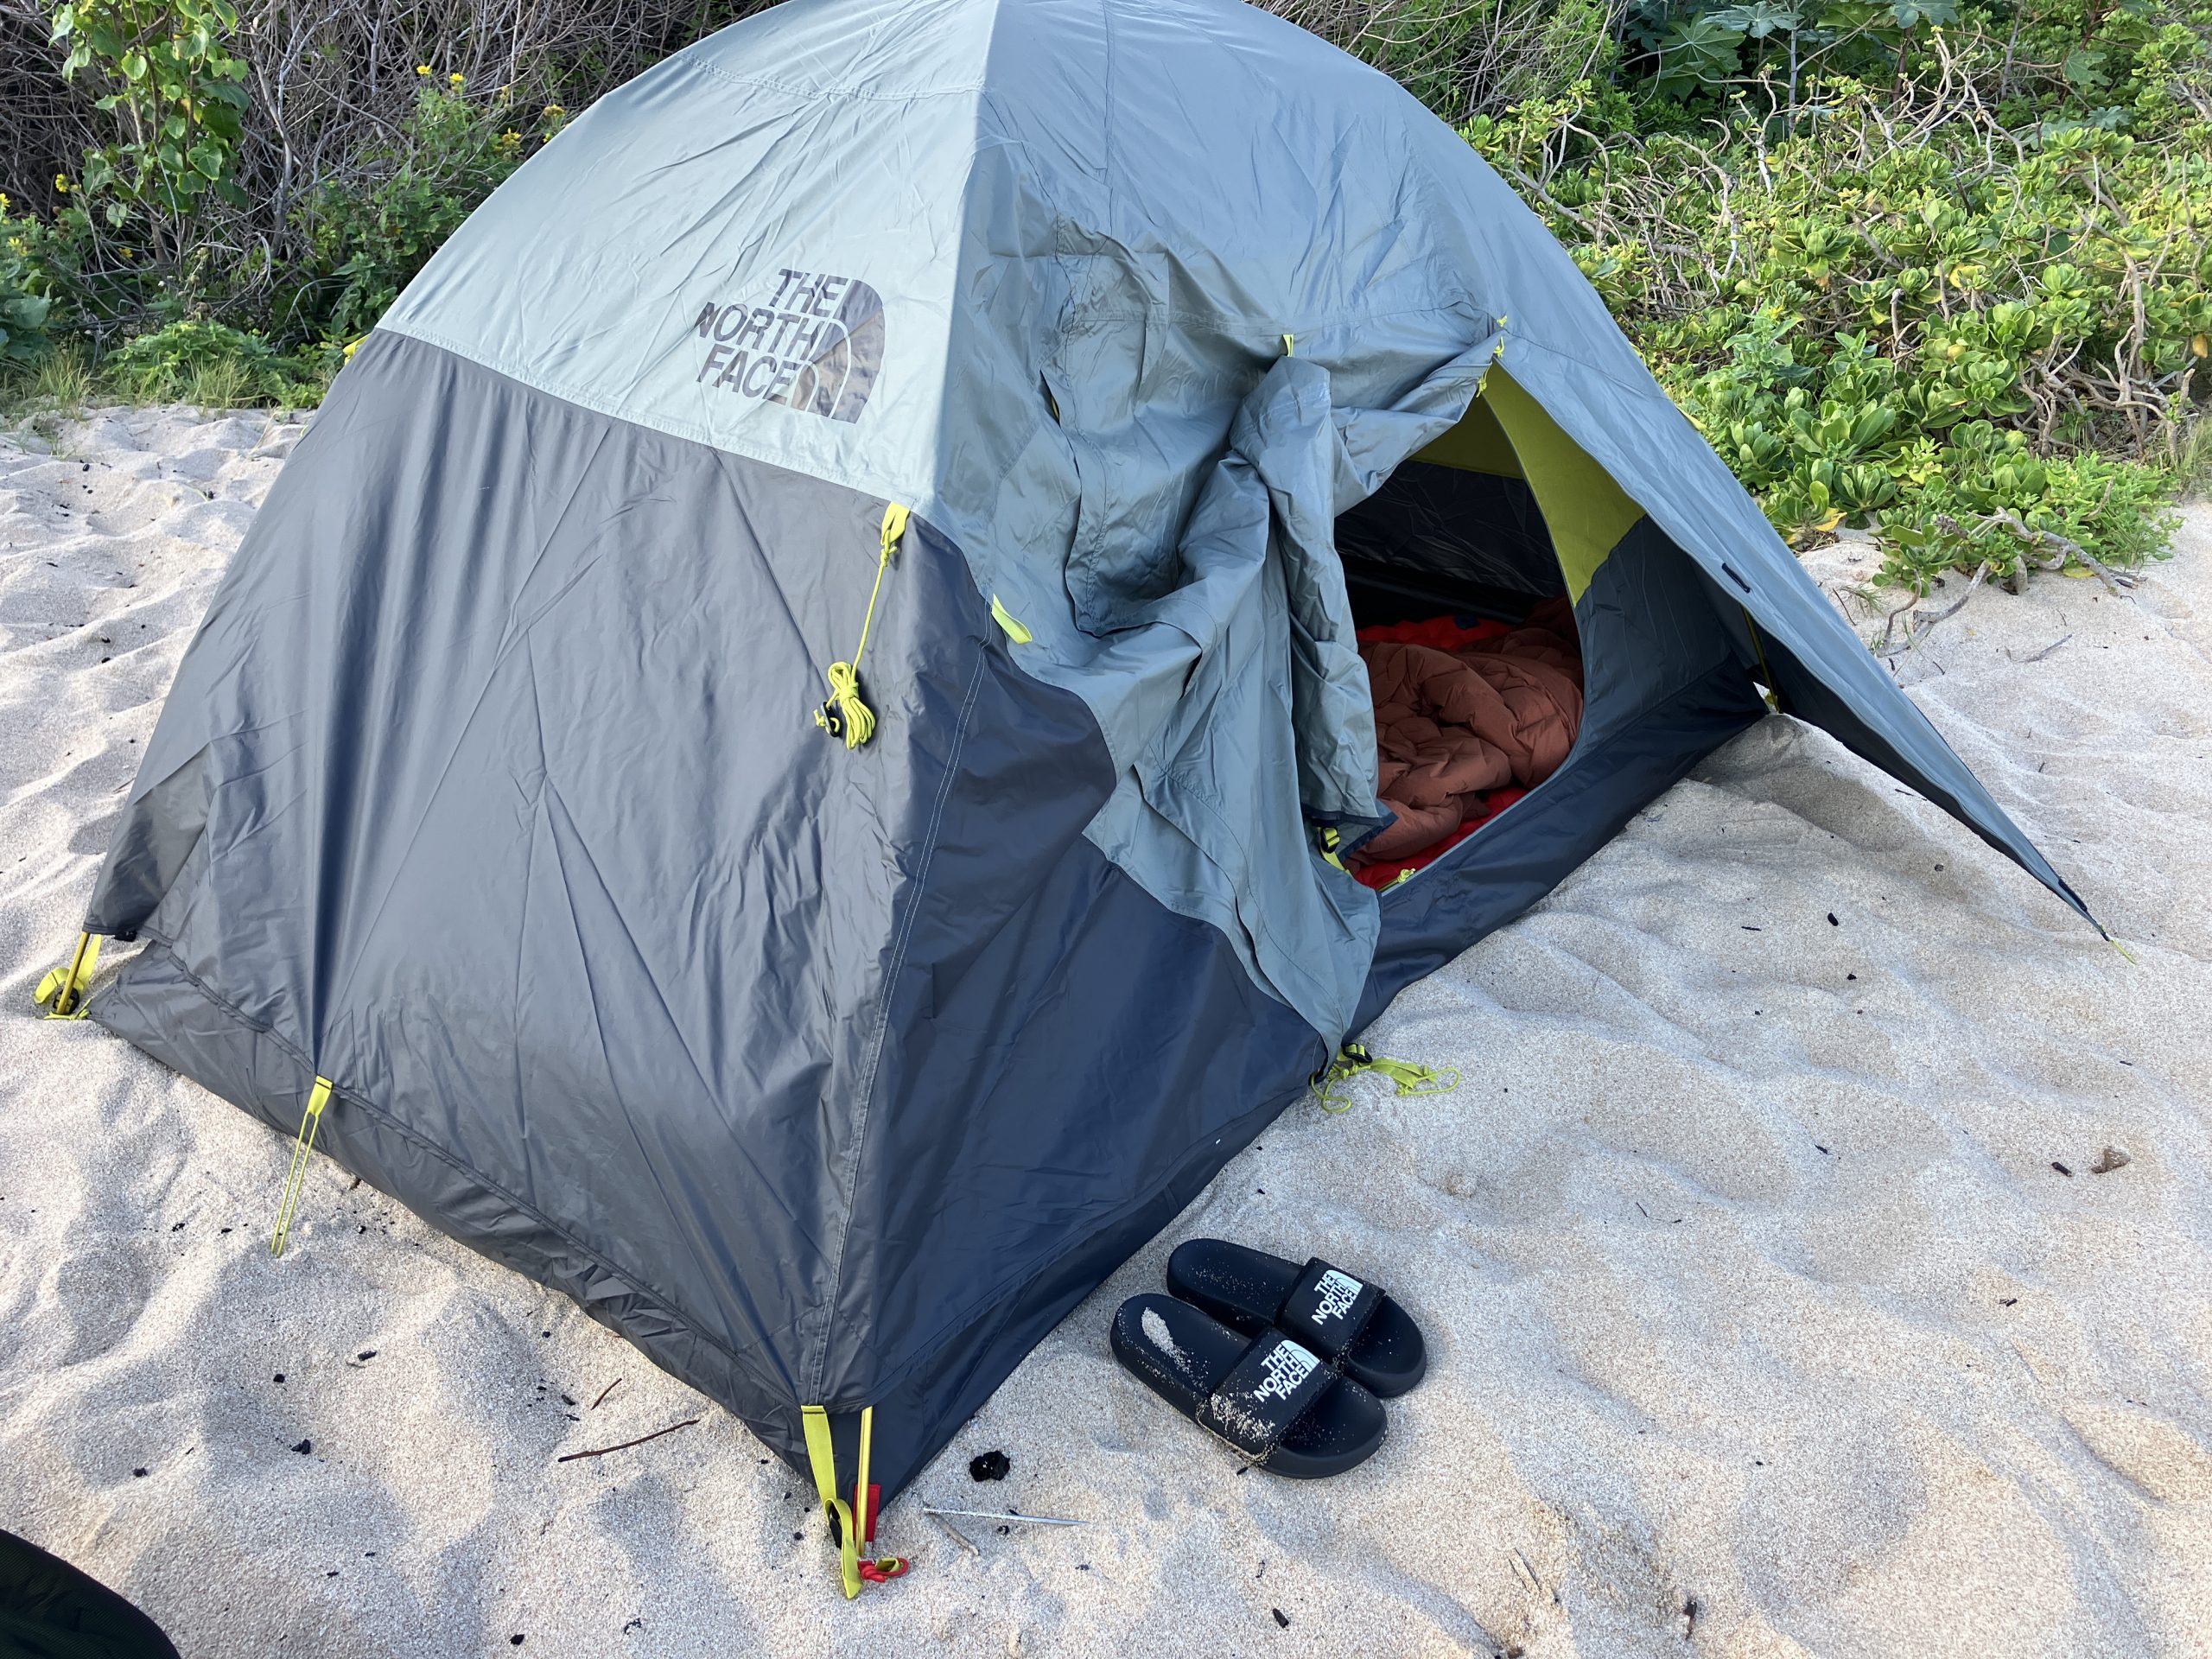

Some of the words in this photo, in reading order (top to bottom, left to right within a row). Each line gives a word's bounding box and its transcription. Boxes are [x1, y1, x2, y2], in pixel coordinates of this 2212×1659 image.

[769, 269, 849, 317] THE
[694, 302, 826, 361] NORTH
[696, 343, 802, 405] FACE
[1311, 1281, 1346, 1325] NORTH
[1314, 1273, 1335, 1294] THE
[1332, 1287, 1357, 1320] FACE
[1253, 1353, 1300, 1402] NORTH
[1261, 1344, 1289, 1371] THE
[1275, 1363, 1309, 1401] FACE
